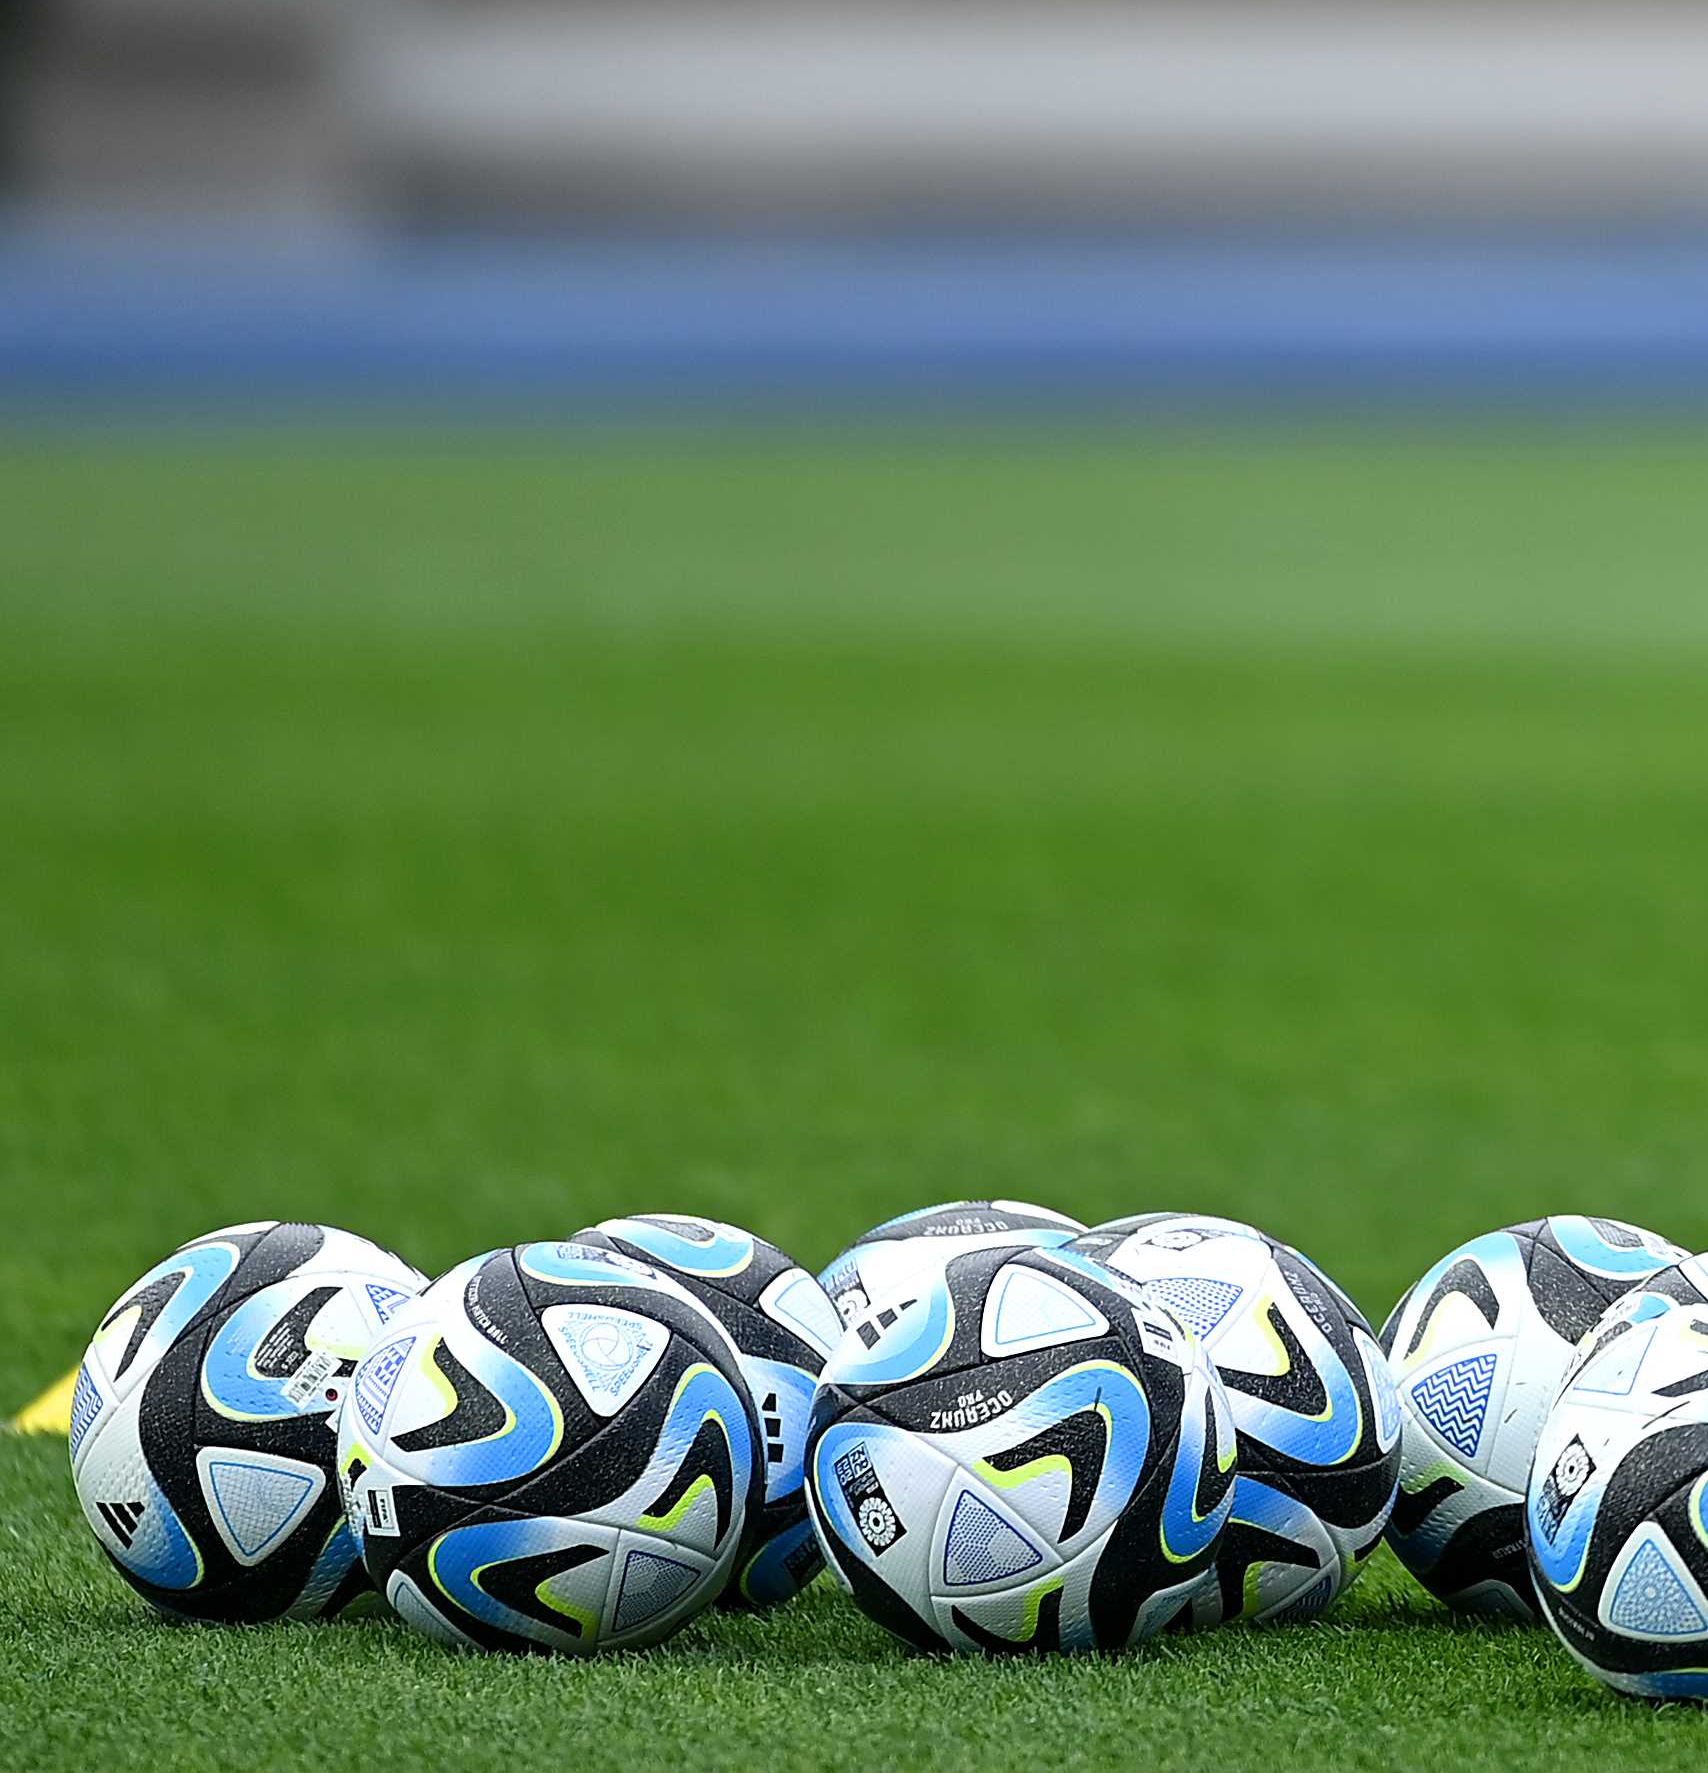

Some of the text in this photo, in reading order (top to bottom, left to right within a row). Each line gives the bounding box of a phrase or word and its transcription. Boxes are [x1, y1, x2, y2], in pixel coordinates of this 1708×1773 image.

[486, 1325, 508, 1345] BALL
[957, 1389, 984, 1408] PRO
[930, 1389, 1013, 1429] OCEAUNZ
